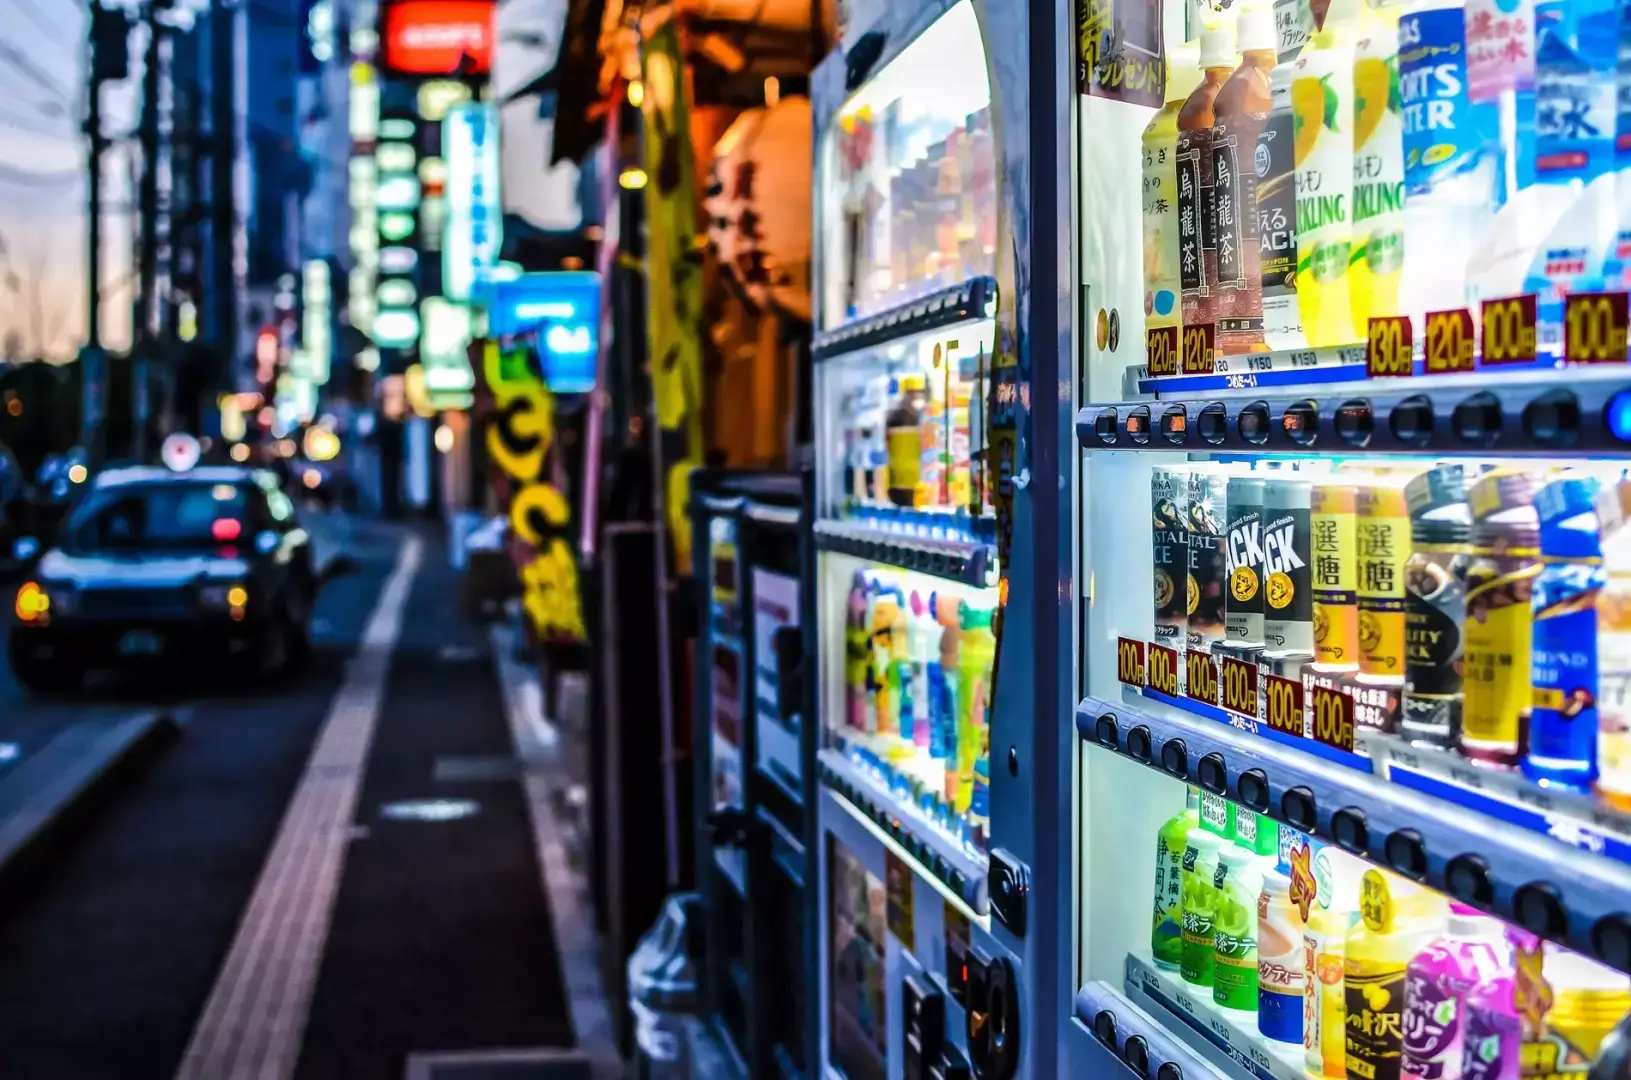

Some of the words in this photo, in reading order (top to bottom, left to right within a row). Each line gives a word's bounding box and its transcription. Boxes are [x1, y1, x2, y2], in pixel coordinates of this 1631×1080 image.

[1179, 167, 1198, 274] 烏龍茶
[1216, 154, 1236, 266] 烏龍茶
[1150, 331, 1177, 372] 120円
[1183, 327, 1214, 371] 120円
[1247, 356, 1273, 370] ¥150
[1369, 319, 1411, 374] 130円
[1427, 313, 1473, 370] 120円
[1119, 641, 1144, 685] 100円
[1149, 647, 1177, 695] 100円
[1187, 653, 1217, 702] 100円
[1224, 661, 1257, 714] 100円
[1268, 679, 1303, 735] 100円
[1313, 689, 1353, 749] 100円
